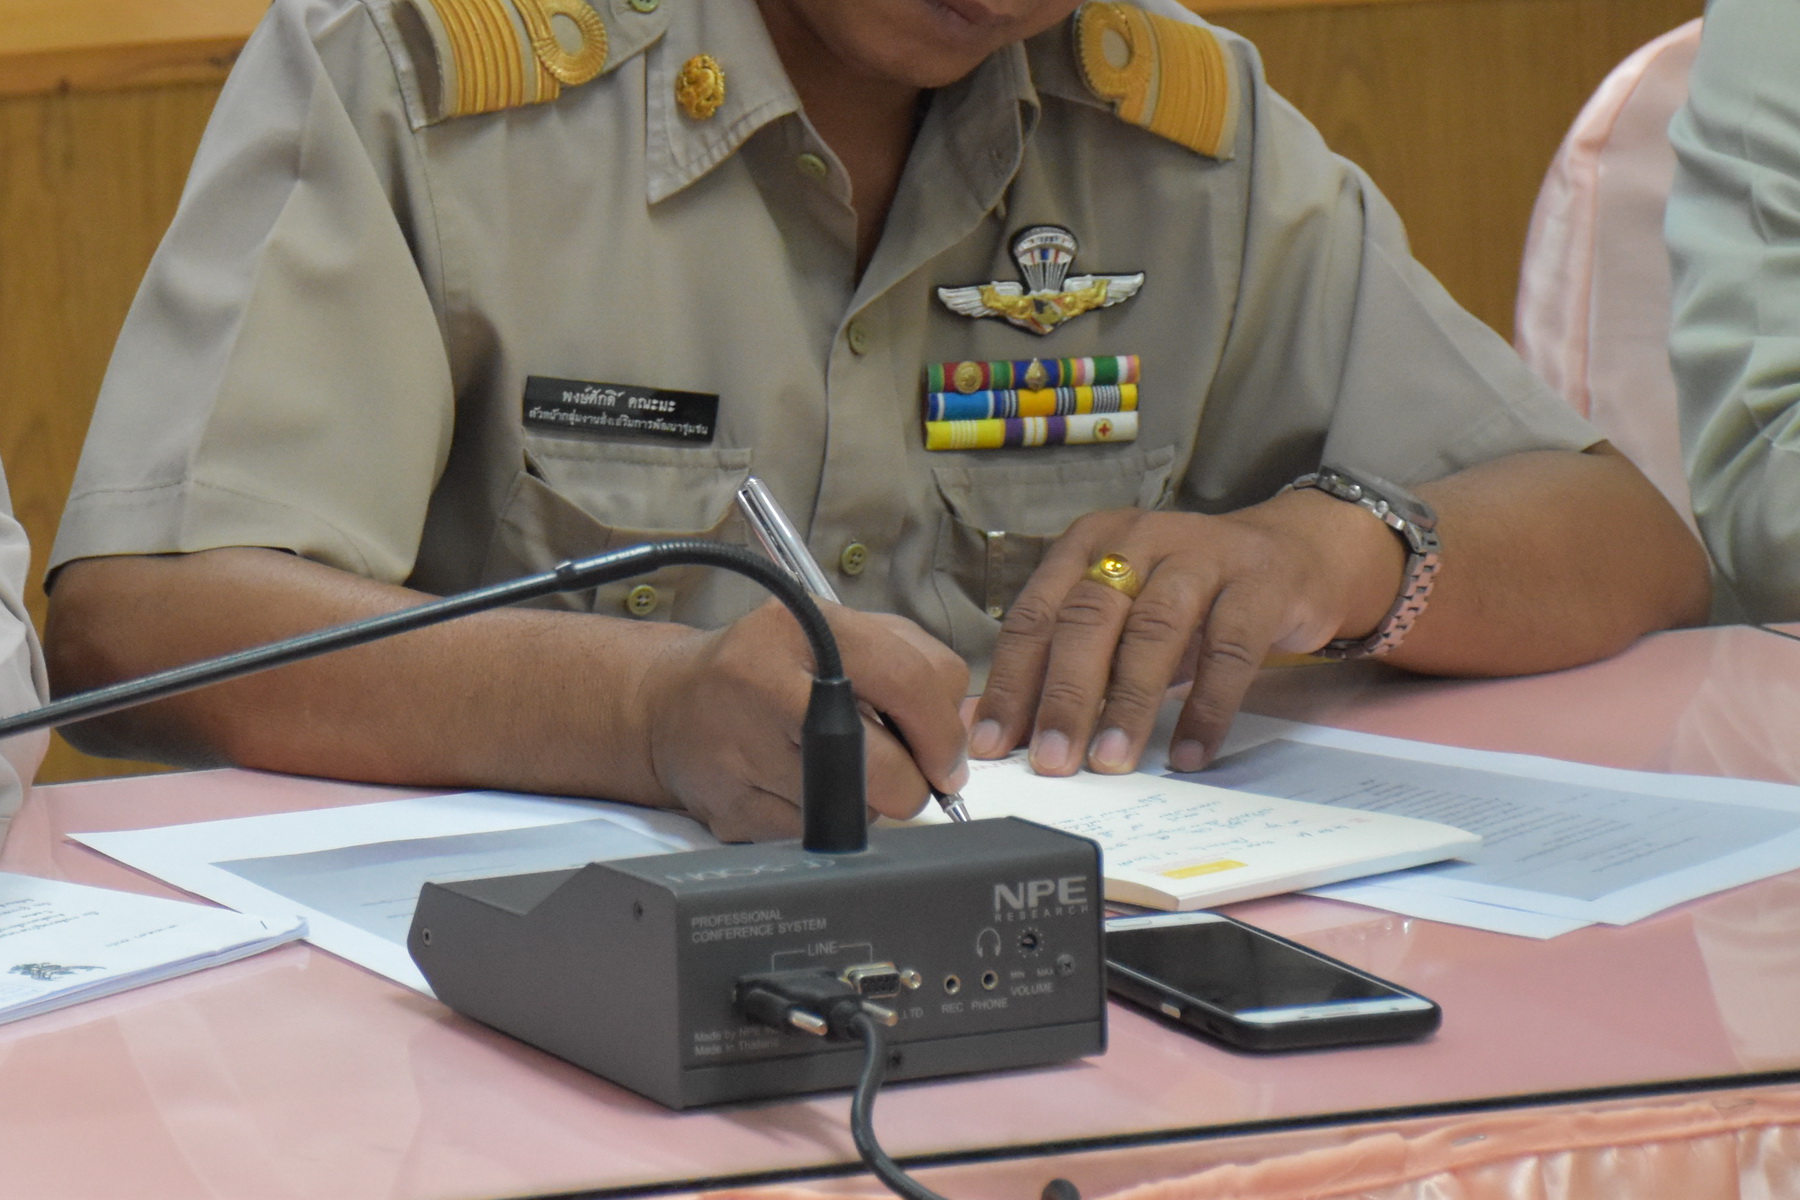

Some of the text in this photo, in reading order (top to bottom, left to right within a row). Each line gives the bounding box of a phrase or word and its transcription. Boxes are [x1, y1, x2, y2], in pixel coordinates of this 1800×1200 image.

[993, 875, 1088, 912] NPE
[691, 909, 784, 928] PROFESSIONAL
[994, 906, 1089, 923] RESEARCH
[691, 917, 828, 944] CONFERENCE SYSTEM
[807, 941, 839, 957] LINE
[1010, 967, 1055, 980] MIN MAX
[1010, 982, 1054, 997] VOLUME
[941, 997, 1008, 1015] REC PHONE
